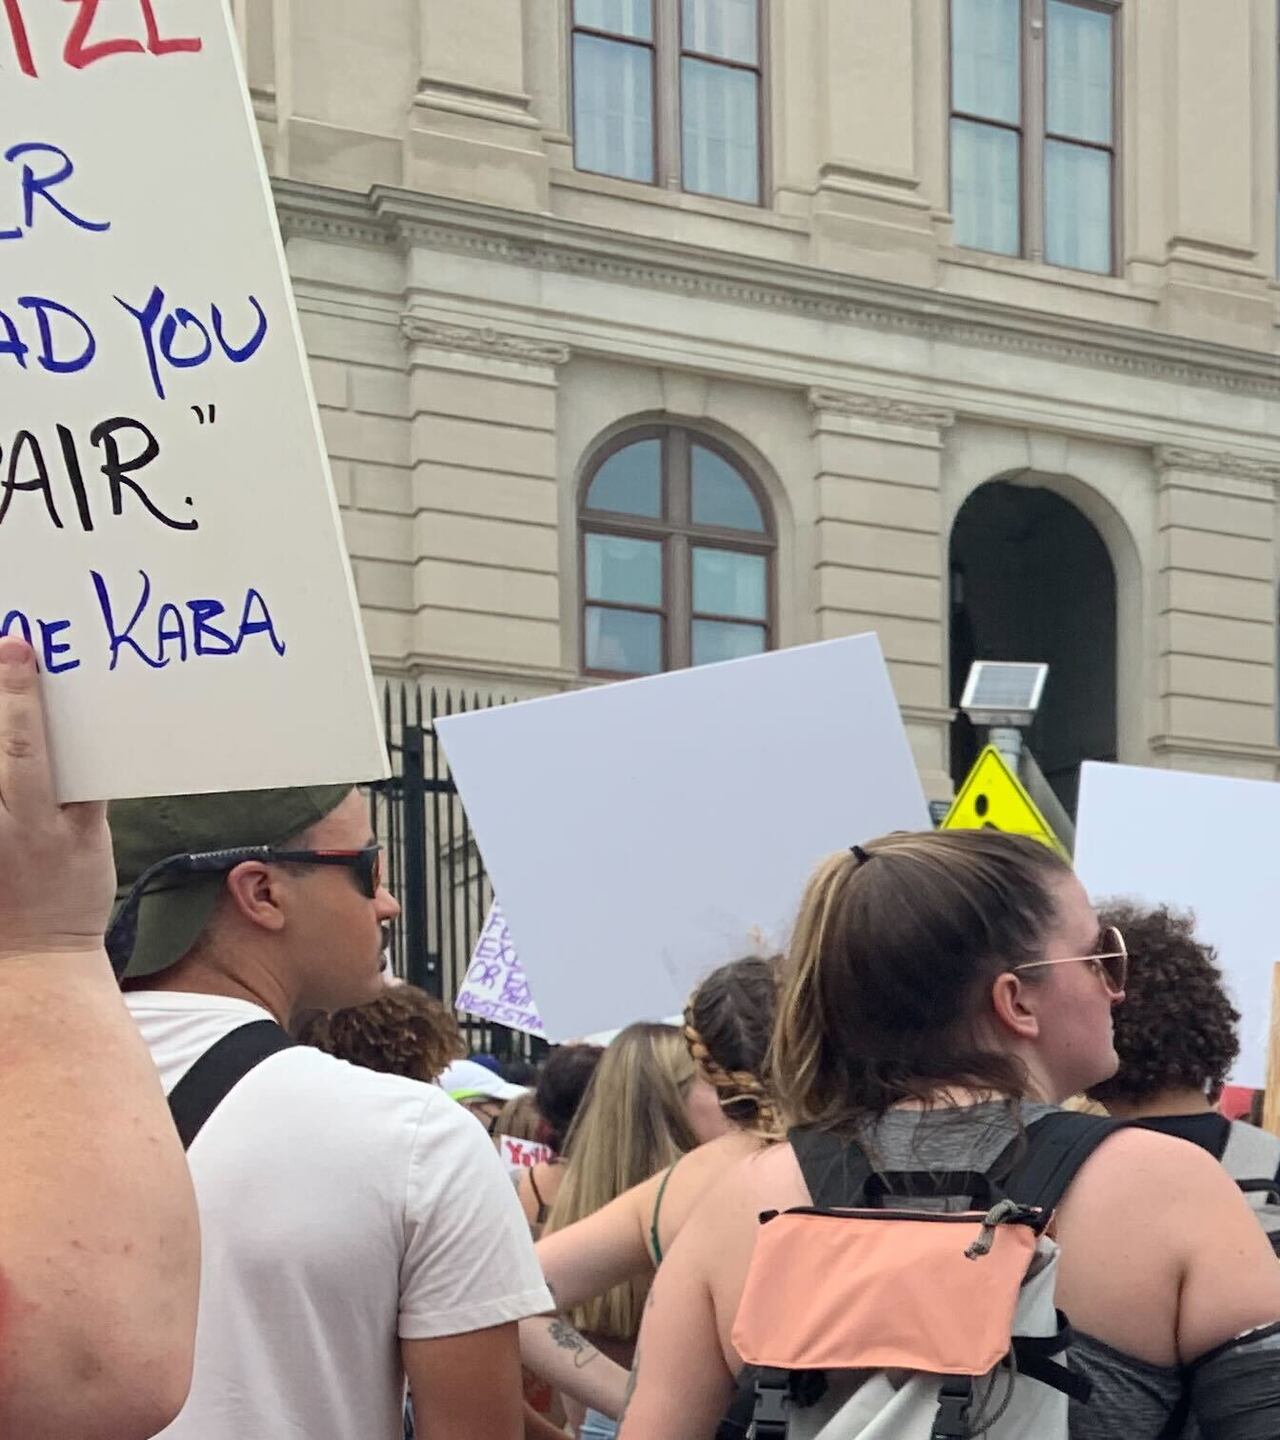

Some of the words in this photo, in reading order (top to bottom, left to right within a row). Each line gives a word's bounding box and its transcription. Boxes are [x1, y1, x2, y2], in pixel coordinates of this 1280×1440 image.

[0, 142, 111, 240] R
[112, 284, 268, 400] YOU
[90, 569, 286, 671] KABA
[467, 959, 502, 990] OR
